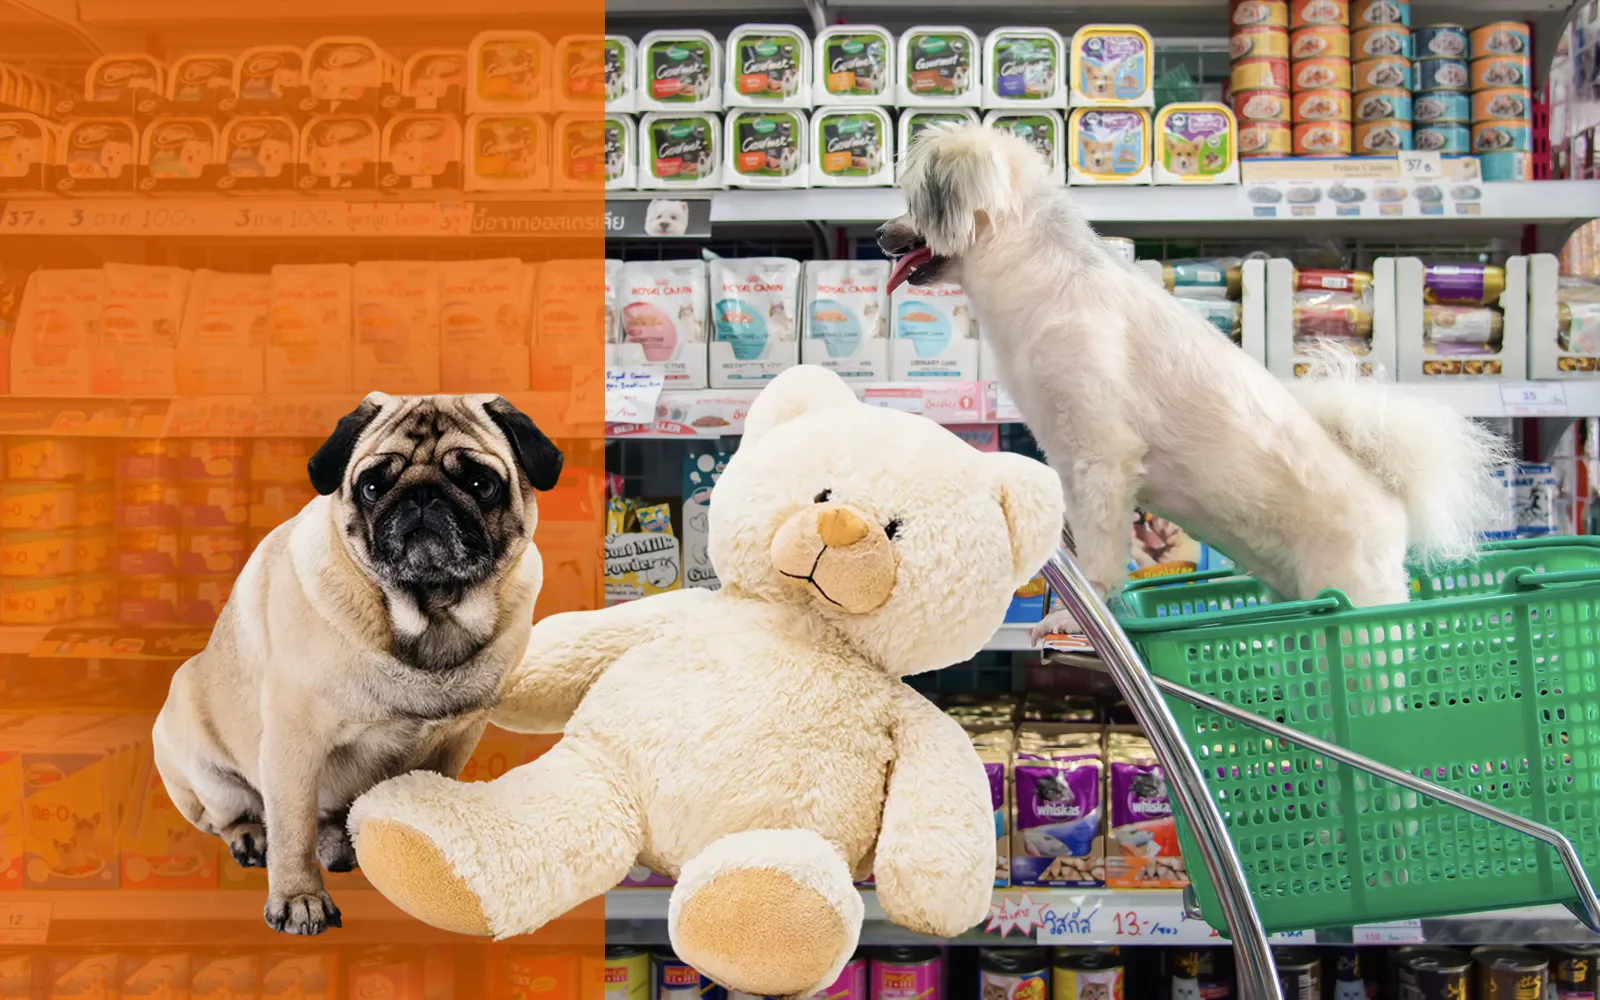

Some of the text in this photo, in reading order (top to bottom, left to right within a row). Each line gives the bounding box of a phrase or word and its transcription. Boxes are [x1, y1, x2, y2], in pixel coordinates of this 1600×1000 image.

[915, 54, 959, 70] Gourmet
[631, 286, 692, 296] ROYAL CANIN
[722, 283, 784, 293] ROYAL CANIN
[817, 284, 878, 294] ROYAL CANIN
[910, 359, 940, 368] URINARY
[636, 535, 675, 555] Milk
[1036, 803, 1081, 817] whiskas
[1132, 801, 1172, 814] whiska
[8, 914, 23, 926] 12
